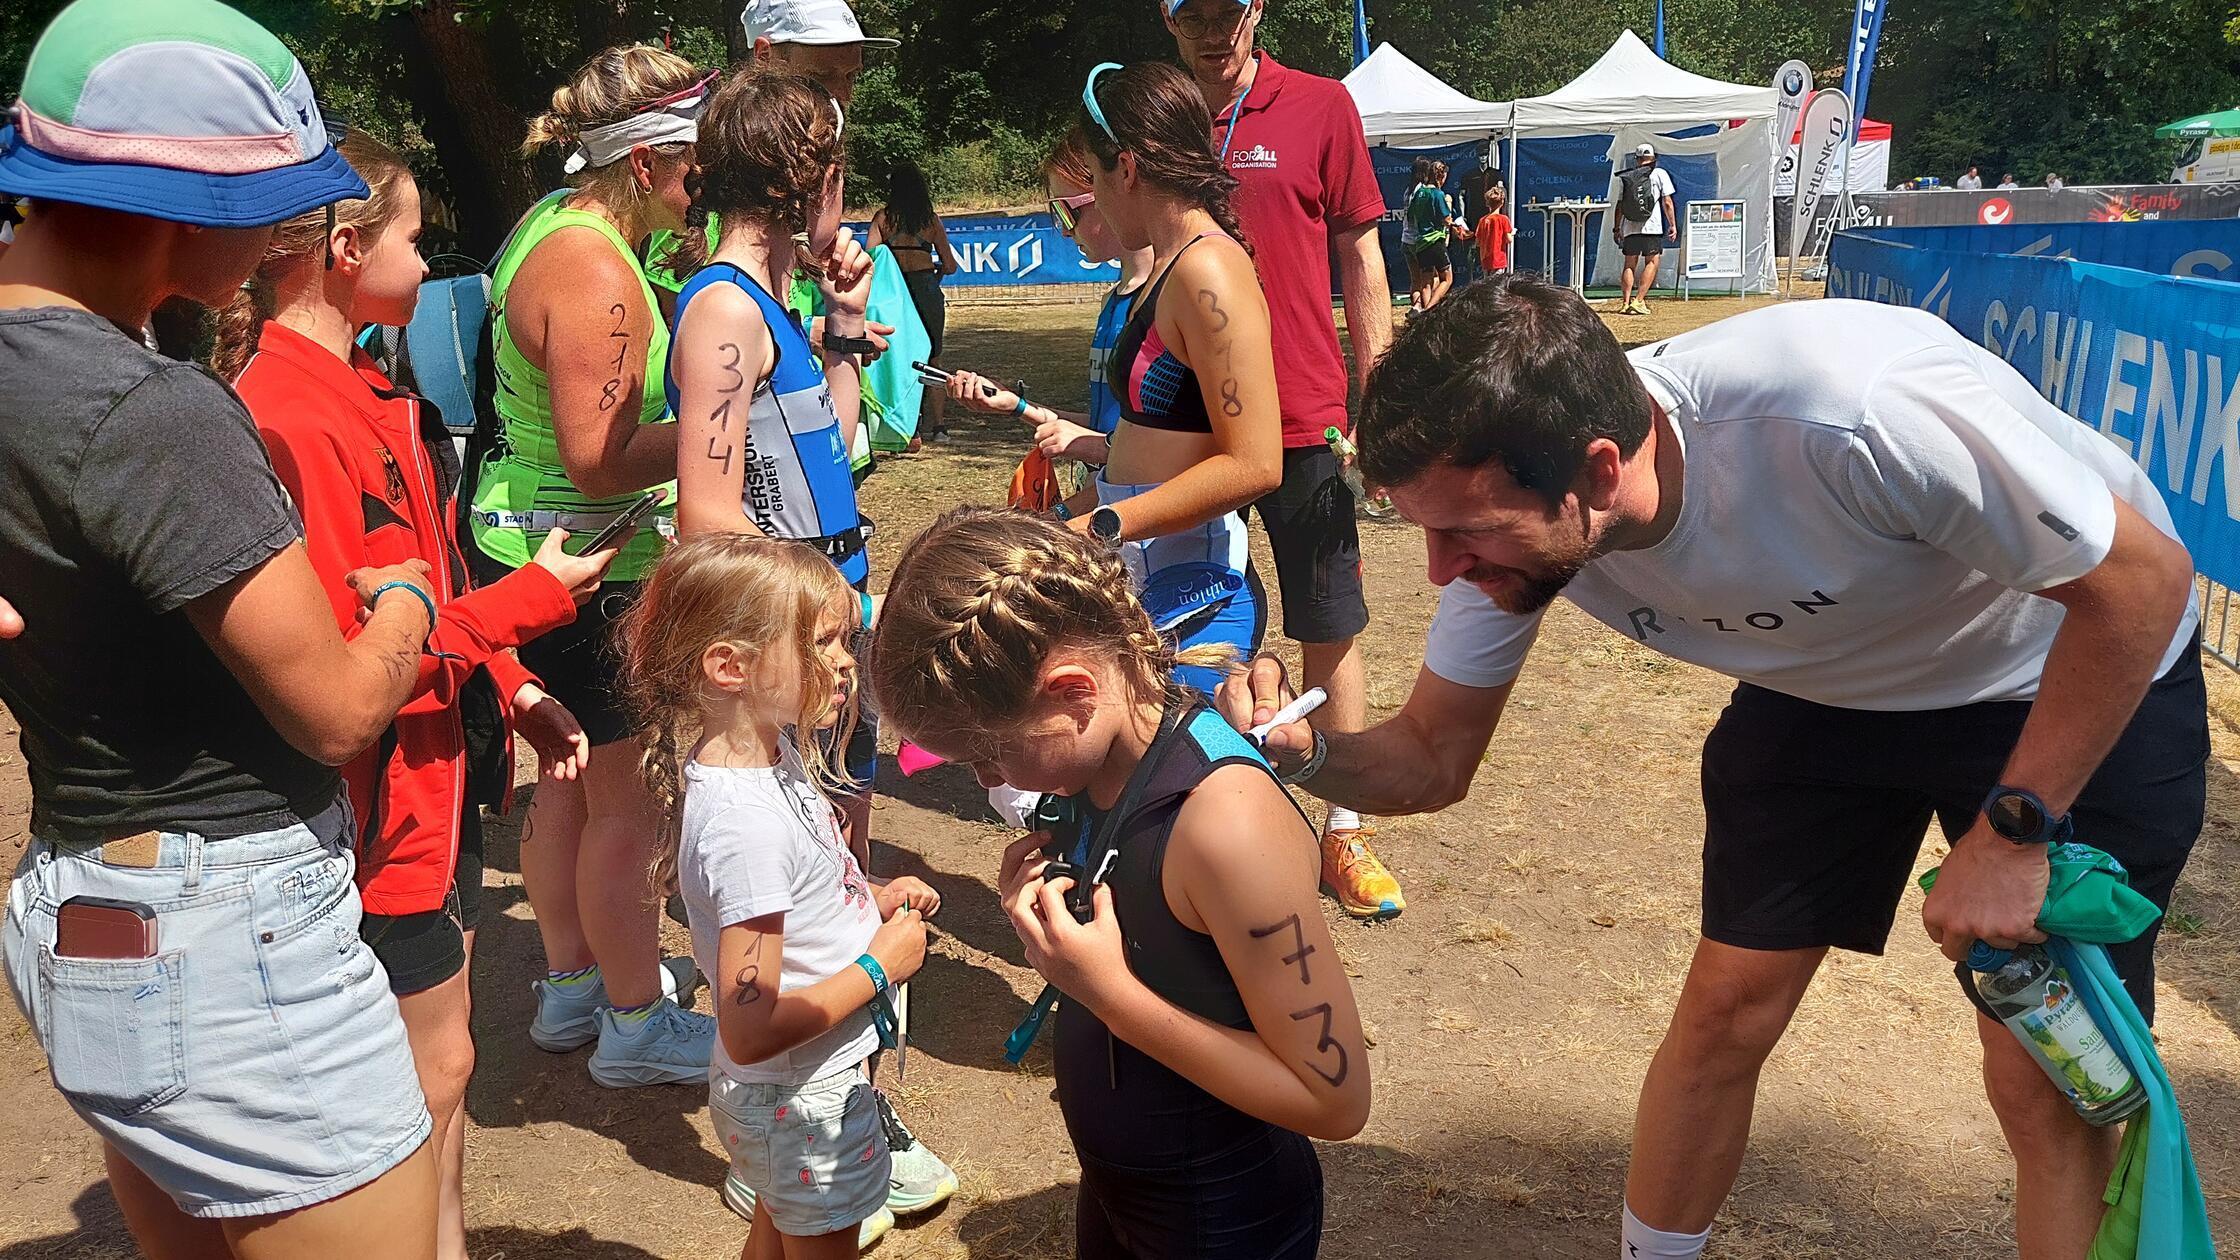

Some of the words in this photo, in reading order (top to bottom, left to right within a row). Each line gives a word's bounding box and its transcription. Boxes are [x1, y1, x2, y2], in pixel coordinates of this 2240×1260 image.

[1233, 151, 1277, 161] FORALL
[2180, 129, 2209, 137] Pyraser
[1800, 138, 1836, 218] SCHLENK
[2131, 192, 2181, 211] Family
[2143, 211, 2160, 220] and
[599, 303, 631, 412] 218
[708, 343, 743, 475] 314
[763, 454, 784, 512] GRABERT
[1249, 912, 1348, 1087] 73
